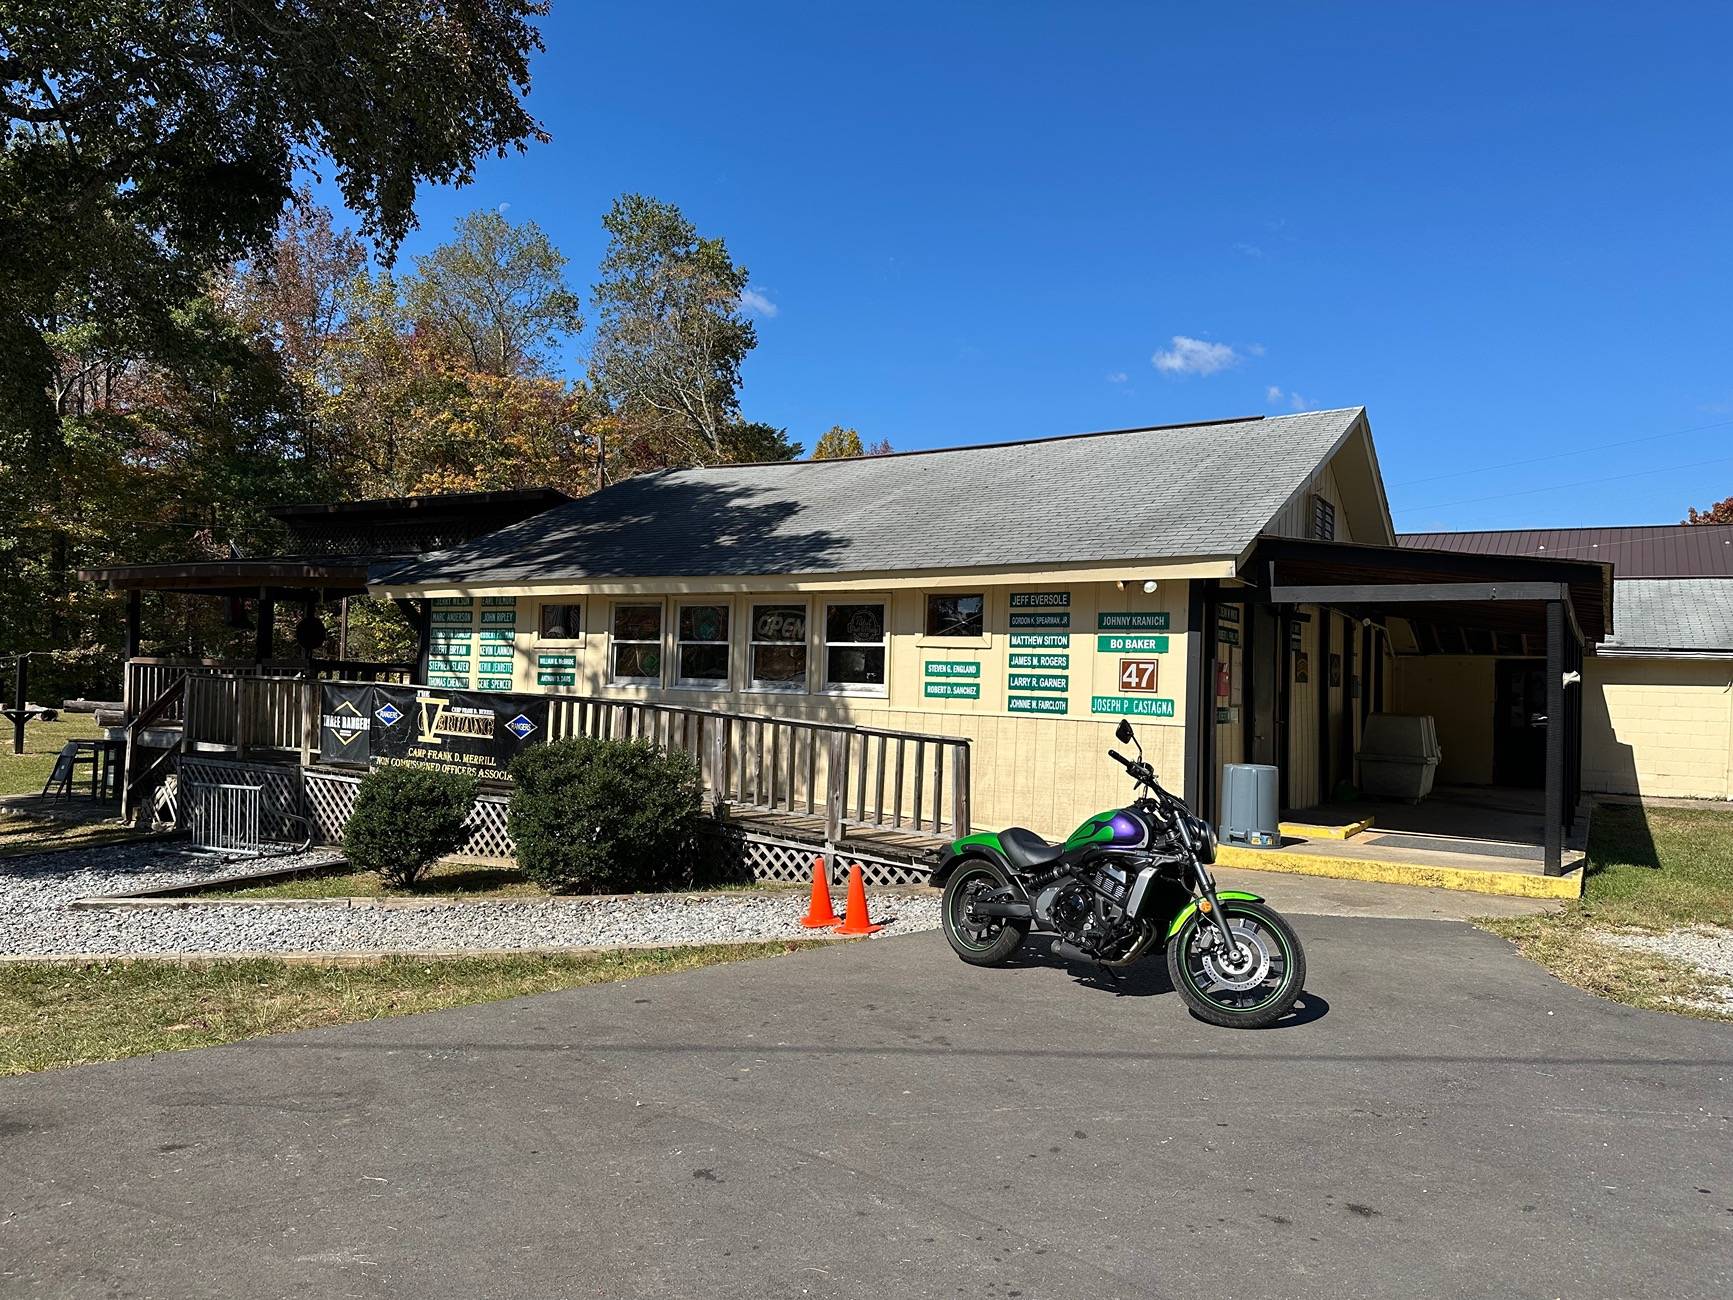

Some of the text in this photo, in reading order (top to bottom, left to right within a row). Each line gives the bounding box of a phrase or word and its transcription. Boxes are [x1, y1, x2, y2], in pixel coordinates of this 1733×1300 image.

[1012, 594, 1067, 605] JEFF EVERSOLE
[1103, 616, 1165, 626] JOHNNY KRANICH
[757, 615, 805, 640] OPEN
[1011, 636, 1068, 646] MATTHEW SITTON
[1110, 639, 1156, 649] BO BAKER
[449, 645, 467, 655] BRYAN
[480, 645, 493, 655] KEVIN
[1011, 656, 1032, 665] JAMES
[1040, 657, 1067, 666] ROGERS
[451, 662, 469, 672] SLATER
[928, 665, 947, 673] STEVEN
[953, 665, 977, 673] ENGLAND
[1122, 663, 1155, 688] 47
[428, 677, 446, 687] THOMAS
[478, 679, 513, 689] GENE SPENCER
[1010, 677, 1067, 688] LARRY R. GARNER
[927, 685, 946, 694] ROBERT
[953, 686, 977, 695] SANCHEZ
[1010, 699, 1031, 709] JOHNNIE
[1038, 700, 1066, 710] FAIRCLOTH
[1092, 699, 1121, 711] JOSEPH
[1133, 699, 1173, 714] CASTAGNA
[380, 710, 398, 719] RANGERS
[323, 714, 341, 728] THREE
[511, 722, 532, 731] RANGERS
[408, 747, 497, 766] CAMP FRANK D. MERRILL
[377, 756, 390, 767] NON
[441, 764, 477, 776] OFFICERS
